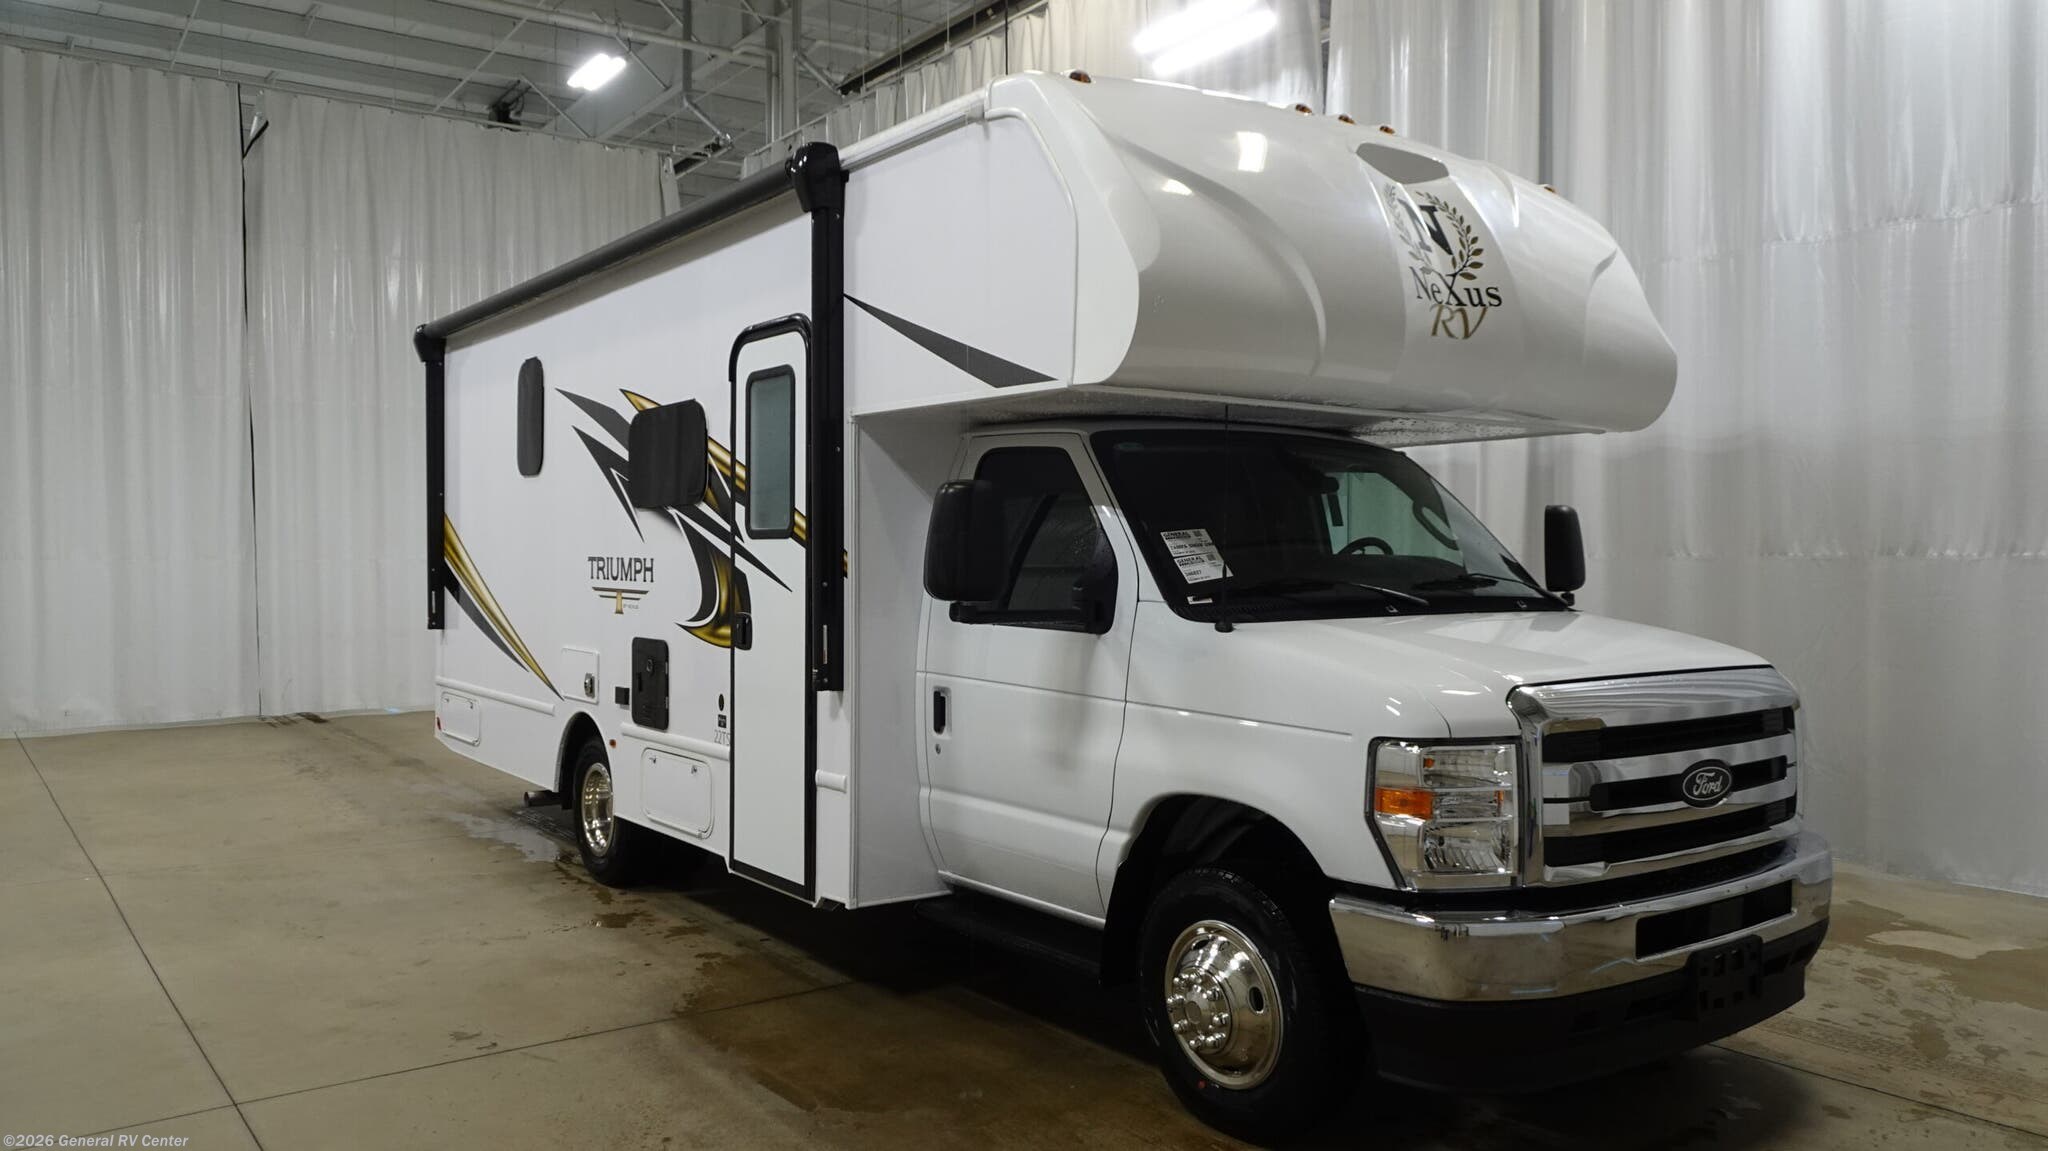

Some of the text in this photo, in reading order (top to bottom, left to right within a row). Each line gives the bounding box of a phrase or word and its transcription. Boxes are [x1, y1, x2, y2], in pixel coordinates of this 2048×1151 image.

[1409, 266, 1502, 308] NeXus
[1430, 303, 1488, 340] RV
[587, 556, 654, 583] TRIUMPH
[1693, 772, 1723, 795] Ford
